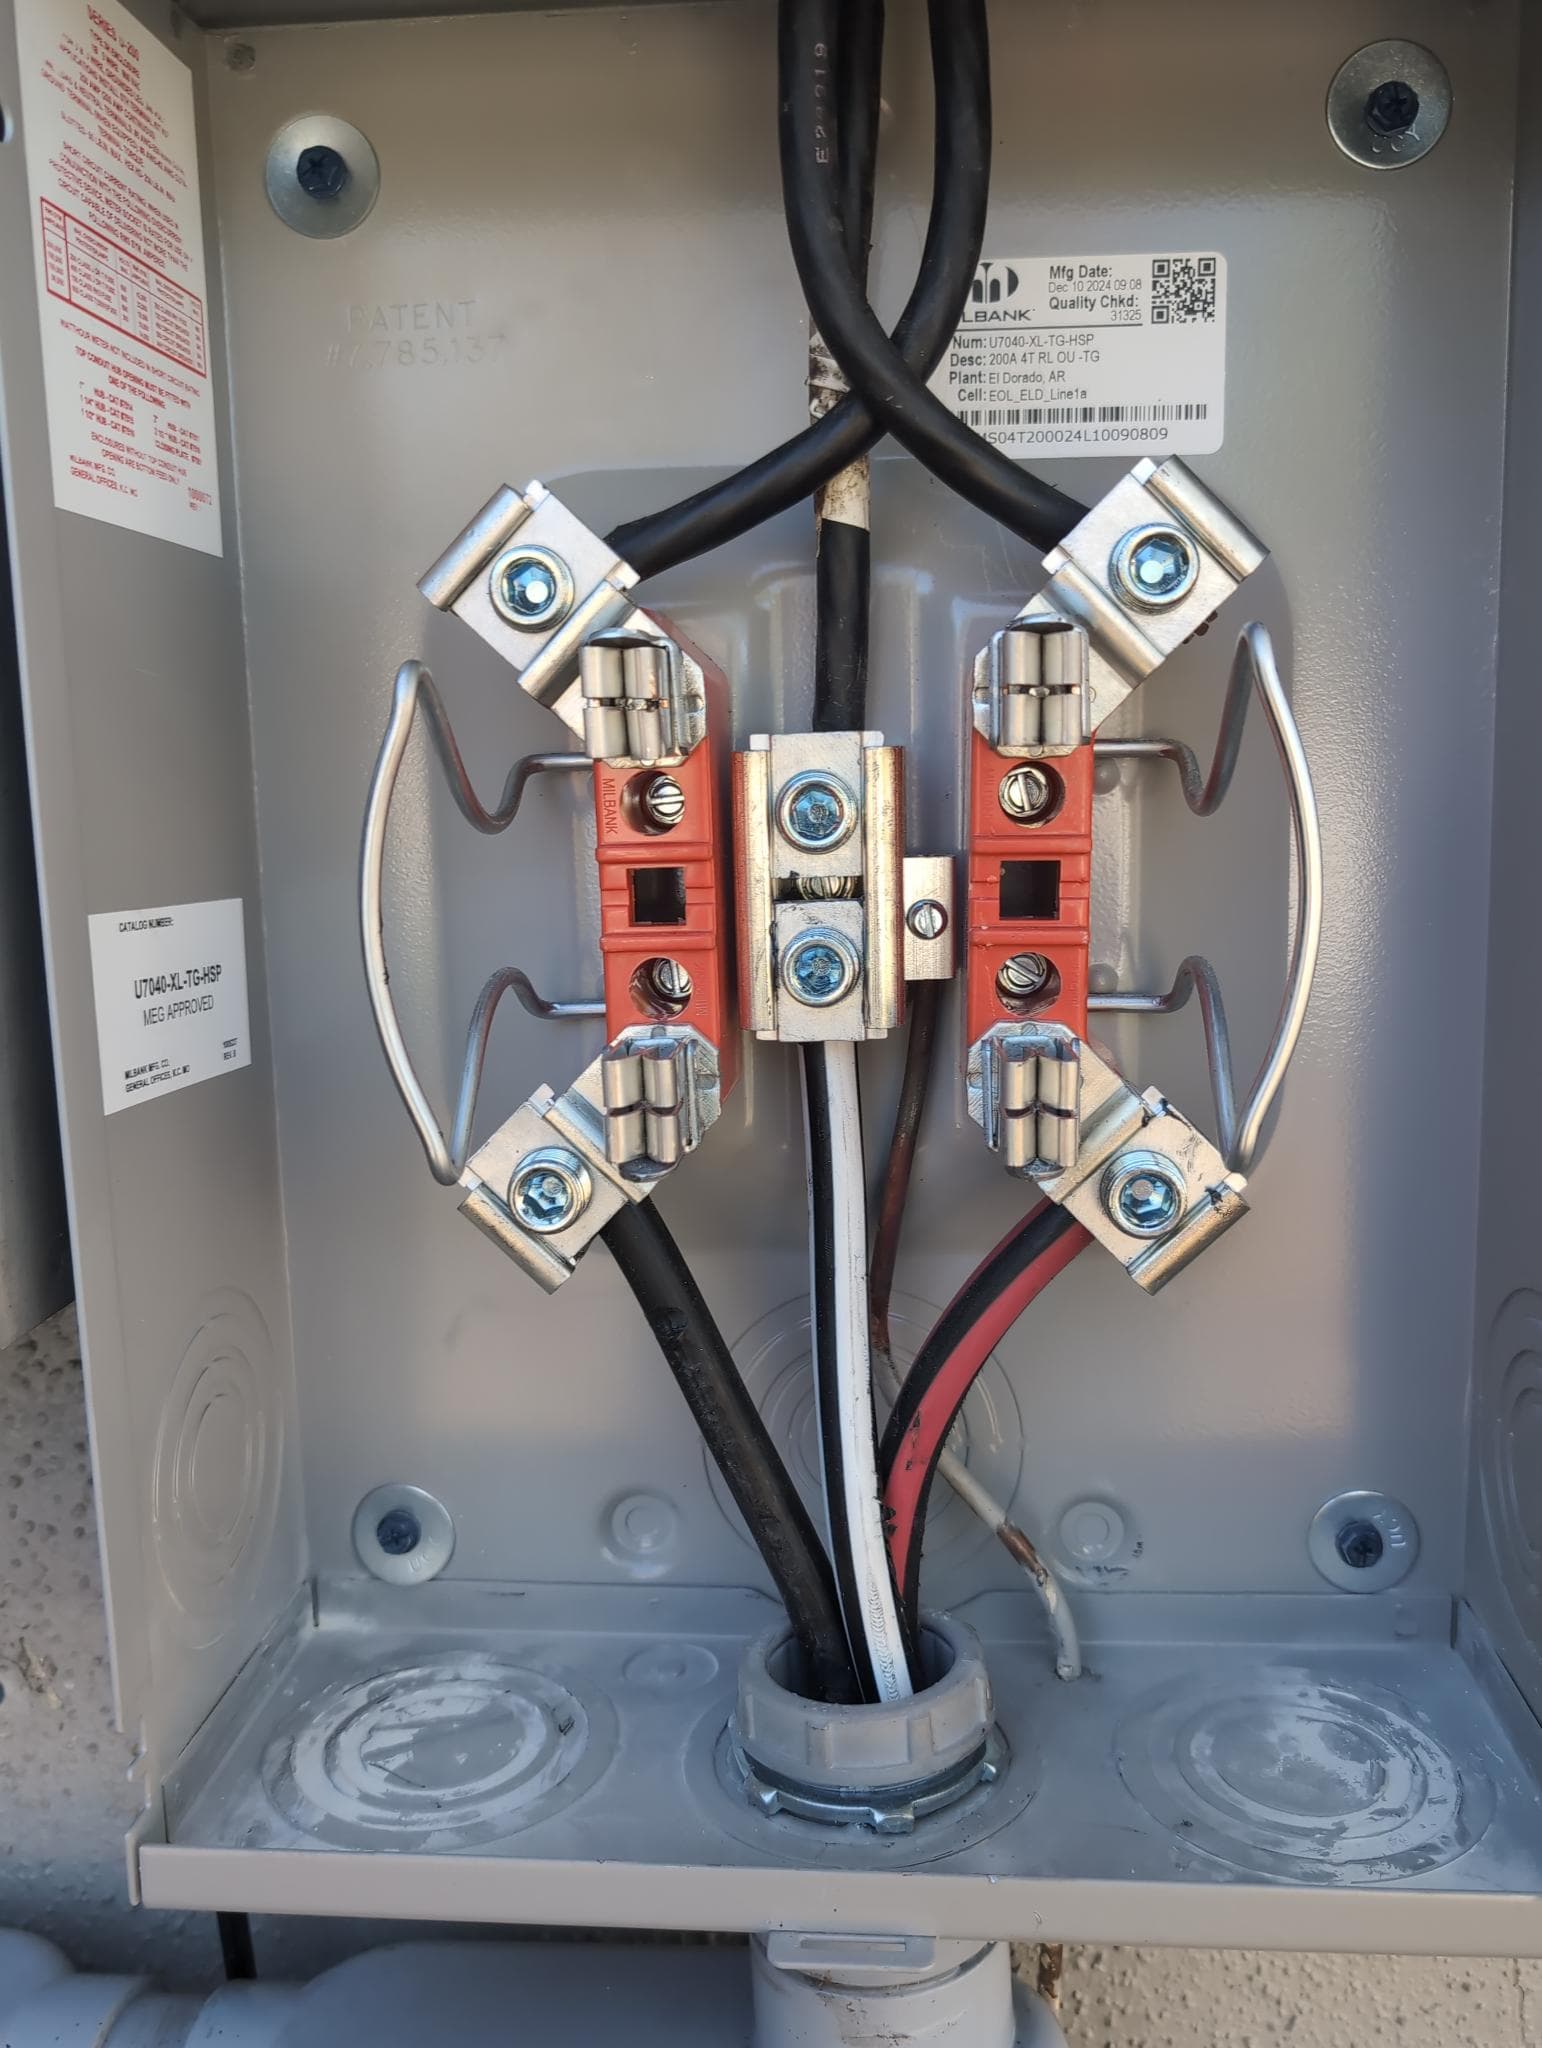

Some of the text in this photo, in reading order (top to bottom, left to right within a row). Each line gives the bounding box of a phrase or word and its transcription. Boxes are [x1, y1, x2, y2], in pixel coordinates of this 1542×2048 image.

[1050, 265, 1112, 281] Mfg Date:
[1049, 281, 1068, 293] Dec
[1086, 280, 1111, 292] 2024
[1050, 295, 1139, 311] Quality Chkd:
[346, 300, 479, 333] PATENT
[962, 310, 1031, 323] LBANK
[1110, 310, 1141, 321] 31325
[953, 334, 1094, 349] Num: U7040-XL-TG-HSP
[950, 354, 986, 367] Desc:
[989, 353, 1017, 365] 200A
[1021, 352, 1035, 363] 4T
[1038, 351, 1053, 364] RL
[949, 370, 1065, 384] Plant: El Dorado, AR
[958, 389, 986, 401] Cell:
[981, 427, 1168, 444] S04T200024L10090809
[602, 778, 618, 834] MILBANK
[119, 920, 147, 933] CATALOG
[135, 964, 222, 999] U7040-XL-TG-HSP
[144, 994, 214, 1026] MEG APPROVED
